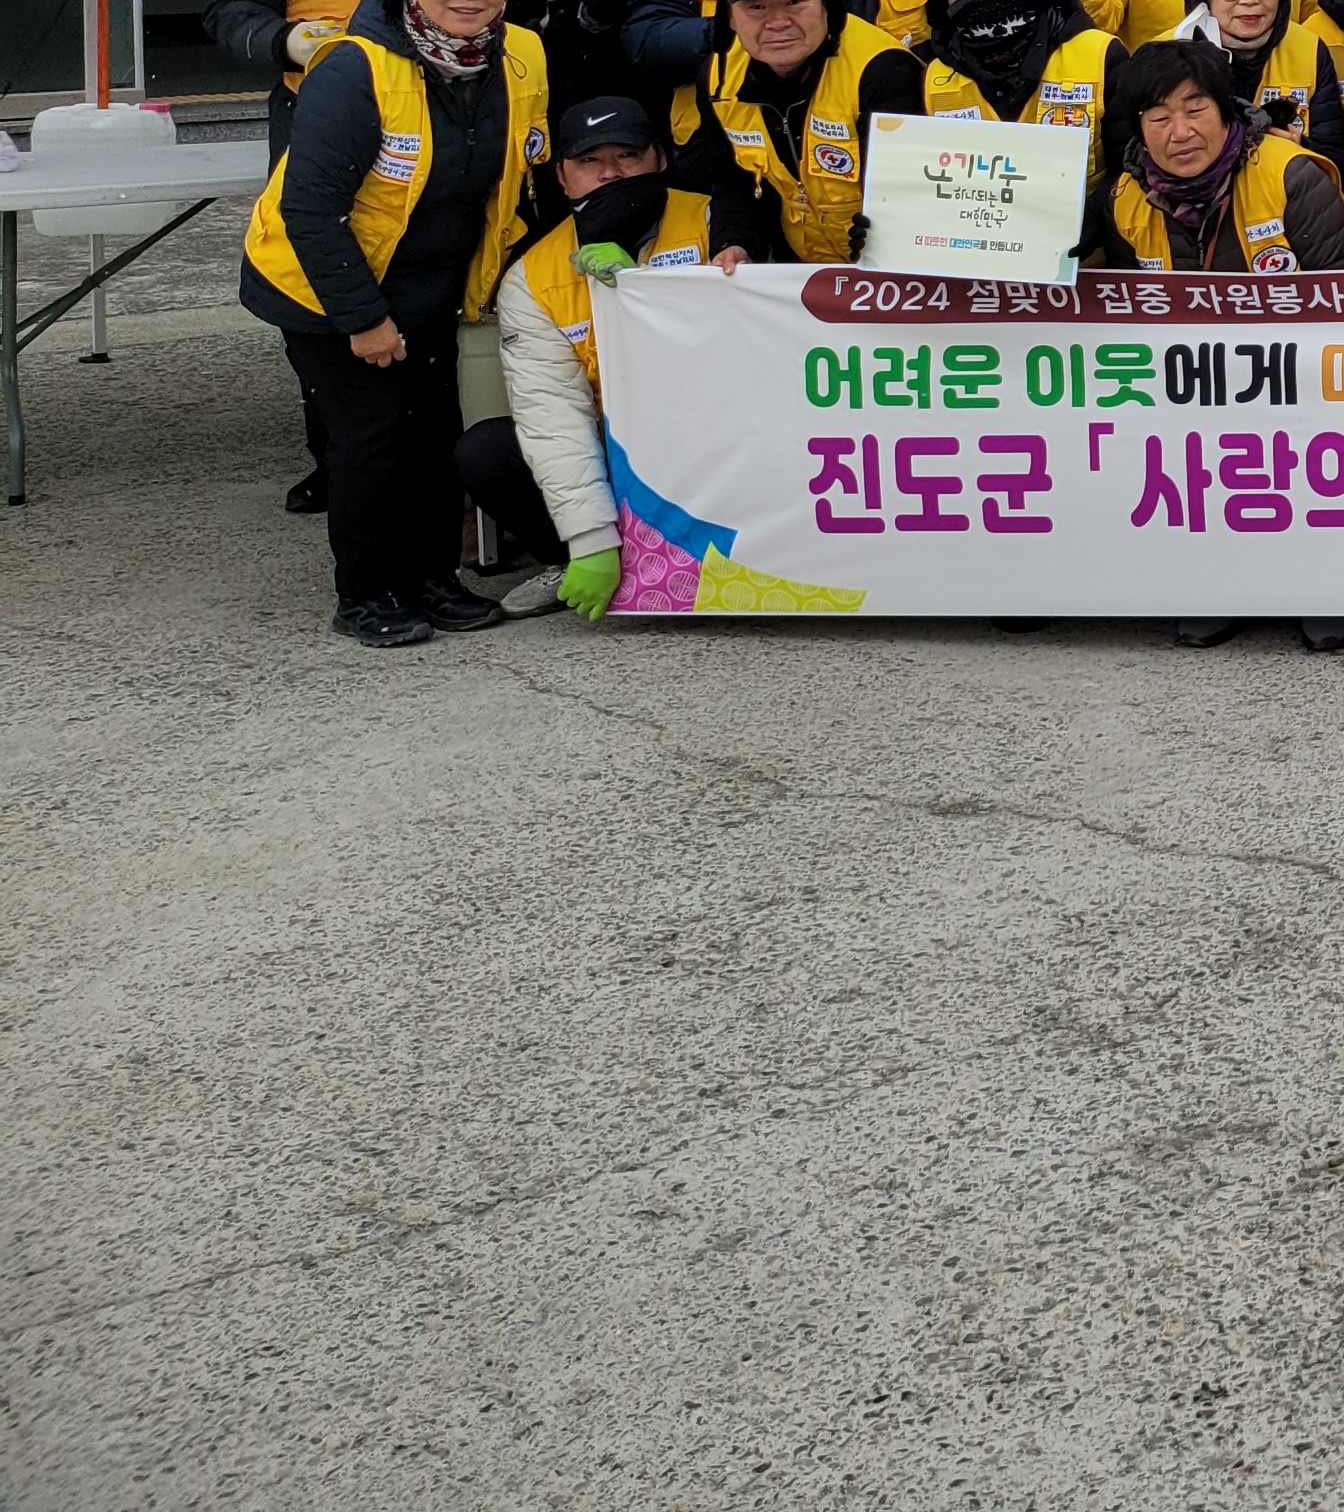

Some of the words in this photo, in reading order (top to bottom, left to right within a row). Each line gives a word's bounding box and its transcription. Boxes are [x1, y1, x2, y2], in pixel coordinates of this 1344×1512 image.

[923, 151, 1029, 205] 온기나눔
[953, 186, 999, 208] 하나되는
[959, 206, 1009, 230] 대한민국
[965, 280, 1082, 316] 설맞이
[1097, 283, 1174, 315] 집중
[803, 343, 1003, 410] 어려운
[1024, 341, 1299, 409] 이웃에게
[806, 432, 1056, 536] 진도군
